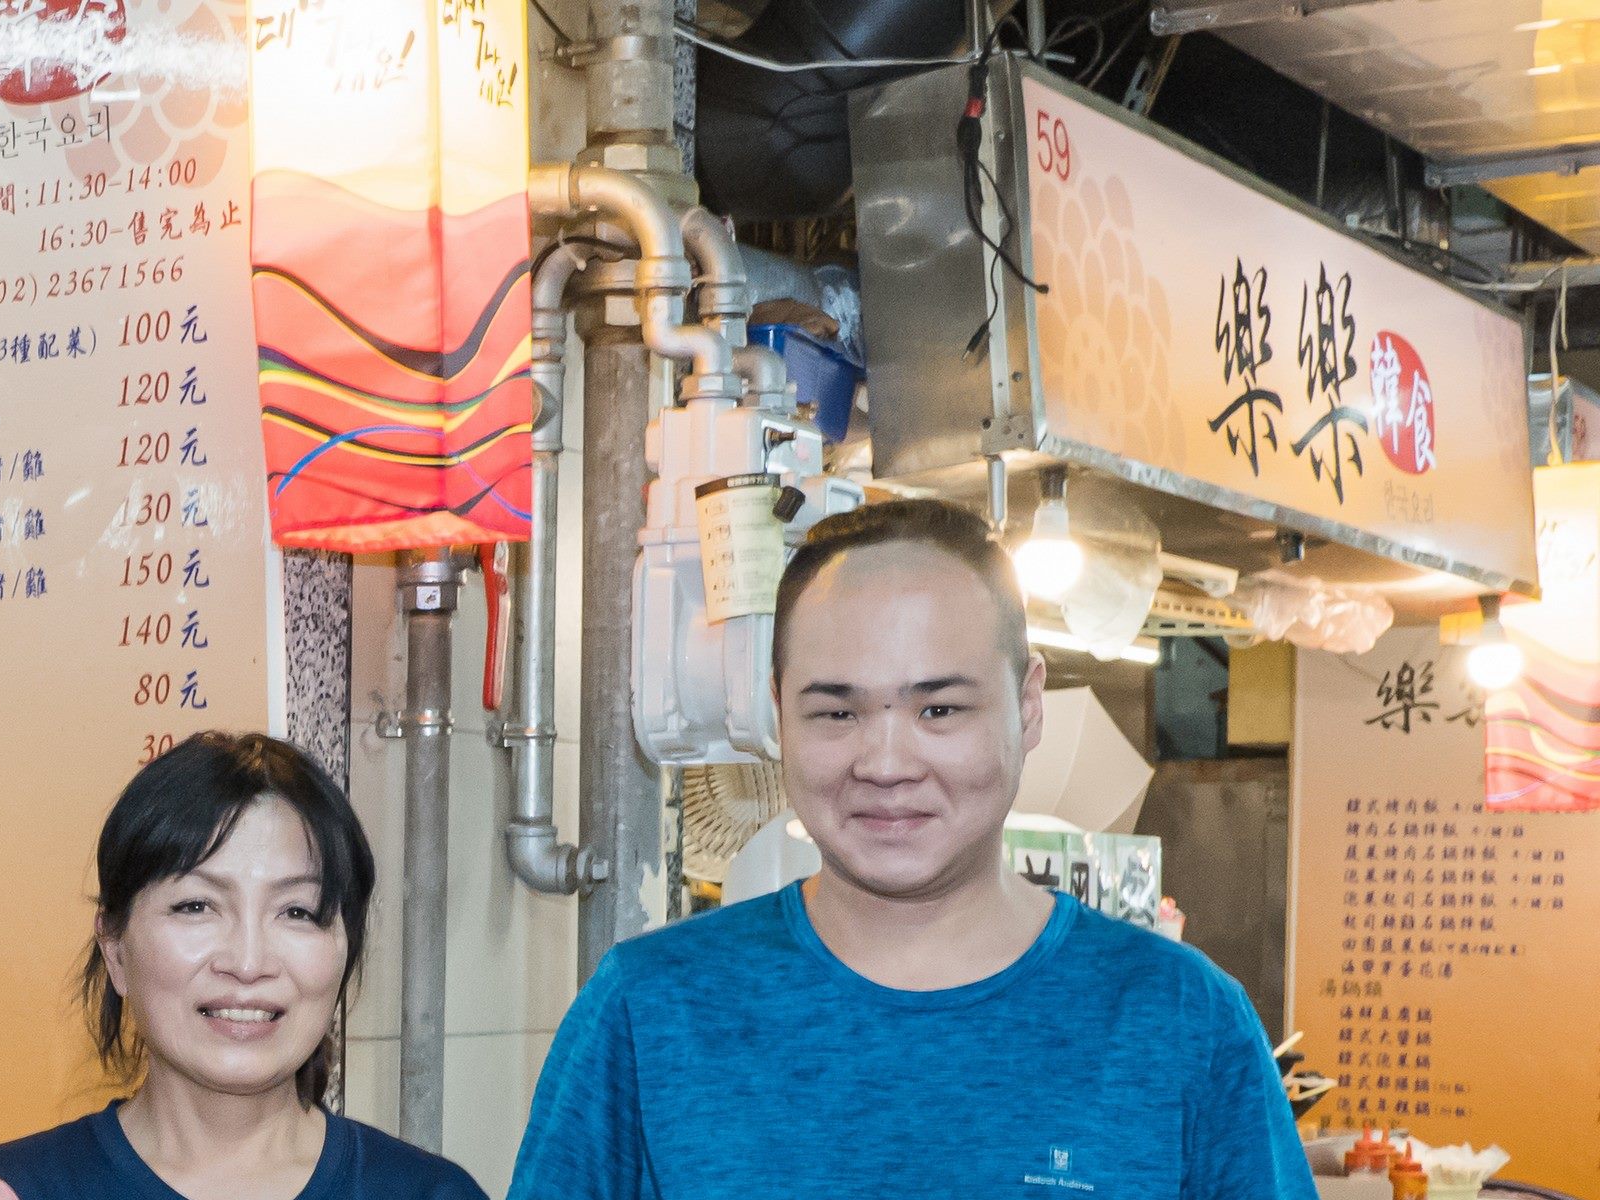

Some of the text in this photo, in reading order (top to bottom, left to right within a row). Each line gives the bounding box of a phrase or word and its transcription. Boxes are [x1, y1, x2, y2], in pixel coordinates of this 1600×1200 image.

[1036, 110, 1070, 182] 59
[118, 305, 207, 347] 100元
[117, 366, 206, 407] 120元
[1208, 255, 1437, 505] 樂樂 韓食
[116, 427, 207, 469] 120元
[119, 549, 210, 589] 150元
[119, 610, 209, 649] 140元
[134, 669, 208, 711] 80元
